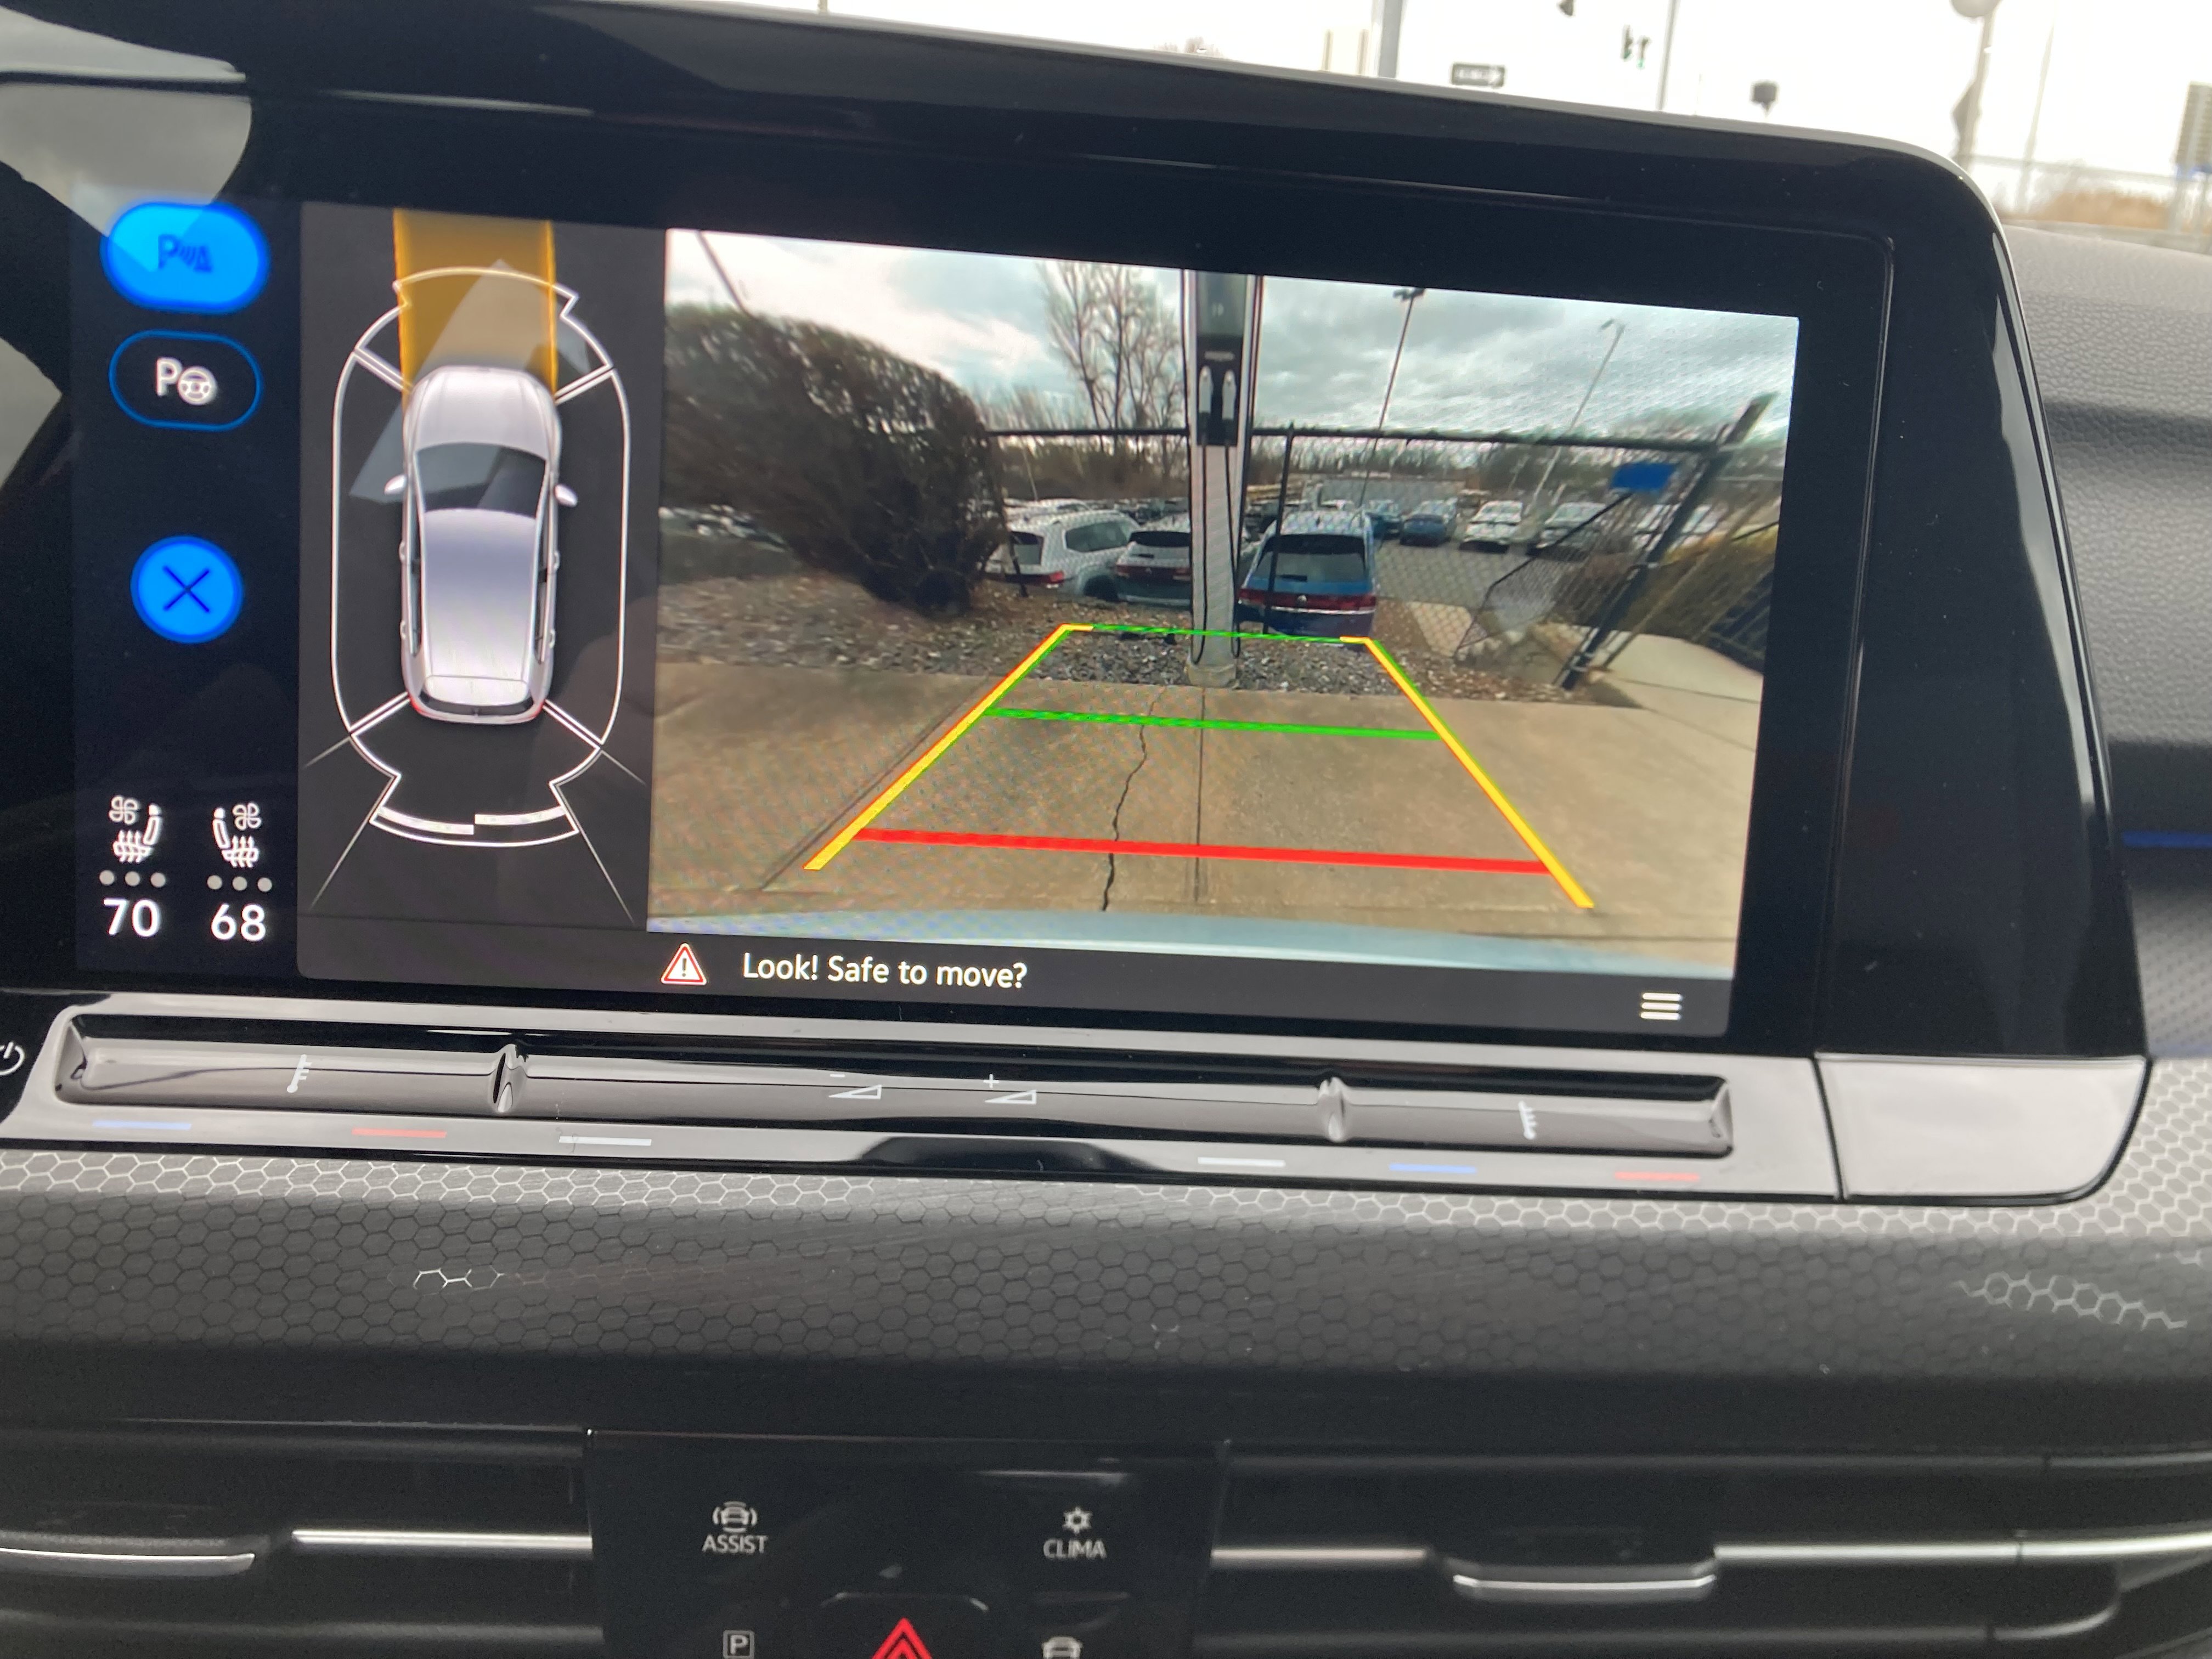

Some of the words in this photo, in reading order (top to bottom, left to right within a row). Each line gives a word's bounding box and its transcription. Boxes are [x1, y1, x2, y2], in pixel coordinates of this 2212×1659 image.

[103, 898, 161, 937] 70
[211, 904, 266, 941] 68
[743, 952, 818, 981] Look!
[827, 956, 890, 984] Safe
[898, 961, 928, 985] to
[936, 962, 1028, 989] move?
[702, 1534, 768, 1554] ASSIST
[1043, 1538, 1107, 1559] CLIMA
[730, 1634, 748, 1655] P
